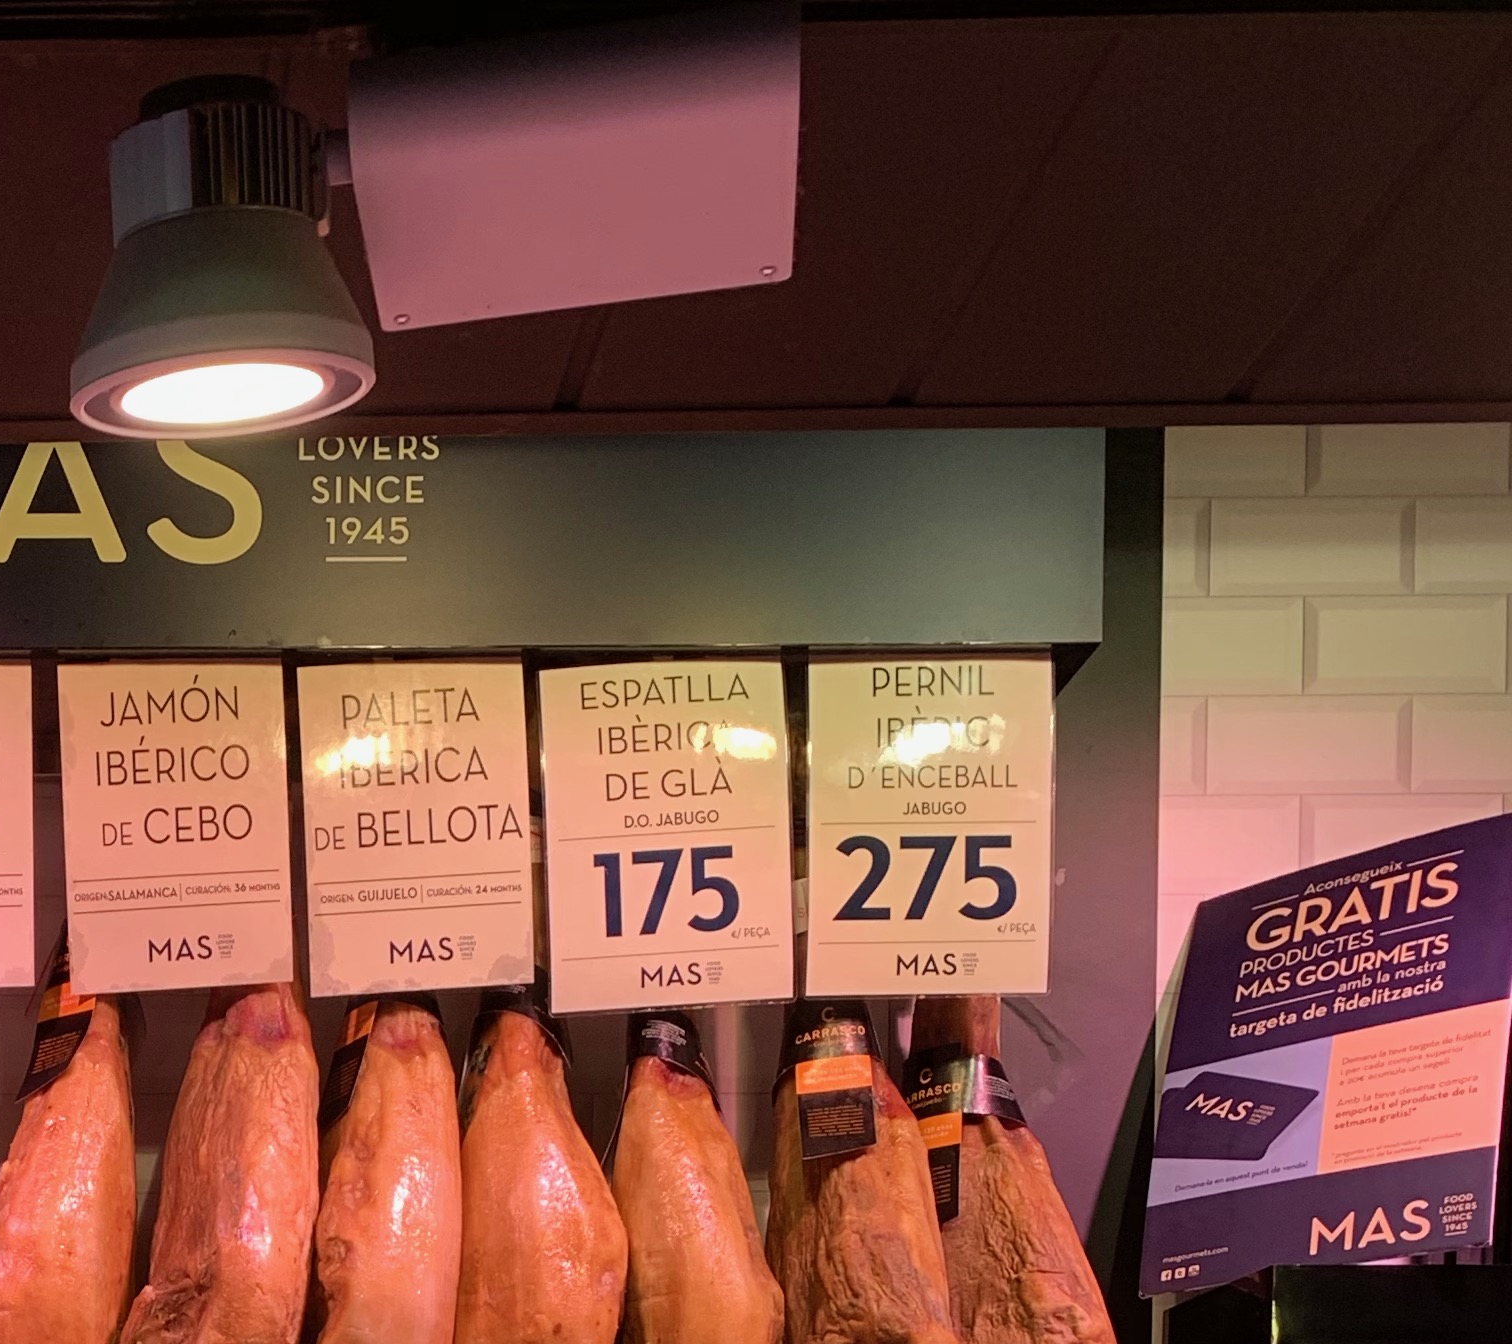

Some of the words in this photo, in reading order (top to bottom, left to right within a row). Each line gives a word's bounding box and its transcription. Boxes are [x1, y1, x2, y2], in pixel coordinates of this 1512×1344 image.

[298, 435, 440, 461] LOVERS
[312, 476, 425, 504] SINCE
[326, 518, 409, 544] 1945
[580, 673, 750, 710] ESPATLLA
[872, 666, 994, 697] PERNIL
[101, 675, 239, 728] JAMÓN
[341, 687, 480, 729] PALETA
[95, 735, 250, 787] IBÉRICO
[606, 772, 648, 802] DE
[661, 758, 733, 797] GLÀ
[655, 808, 720, 827] JABUGO
[902, 800, 967, 817] JABUGO
[101, 822, 133, 848] DE
[144, 804, 253, 843] CEBO
[314, 826, 348, 852] DE
[359, 805, 524, 848] BELLOTA
[594, 845, 739, 937] 175
[833, 835, 1017, 921] 275
[1304, 860, 1403, 896] Aconsegueix
[107, 886, 178, 902] SALAMANCA
[357, 887, 419, 903] GUIJUELO
[1246, 861, 1459, 952] GRATIS
[743, 926, 771, 939] PEÇA
[149, 935, 212, 962] MAS
[390, 936, 454, 964] MAS
[1240, 930, 1374, 978] PRODUCTES
[641, 962, 702, 988] MAS
[895, 952, 958, 977] MAS
[1235, 973, 1290, 1002] MAS
[1296, 933, 1449, 986] GOURMETS
[1337, 973, 1372, 994] amb
[1375, 968, 1390, 985] la
[1393, 958, 1447, 983] nostra
[1230, 1011, 1296, 1038] targeta
[1302, 1001, 1328, 1022] de
[1333, 975, 1444, 1014] fidelització
[1438, 1201, 1478, 1215] LOVERS
[1443, 1192, 1474, 1205] FOOD
[1309, 1199, 1431, 1254] MAS
[1441, 1210, 1473, 1224] SINCE
[1444, 1220, 1469, 1232] 1945
[1161, 1245, 1230, 1265] masgourmets.com
